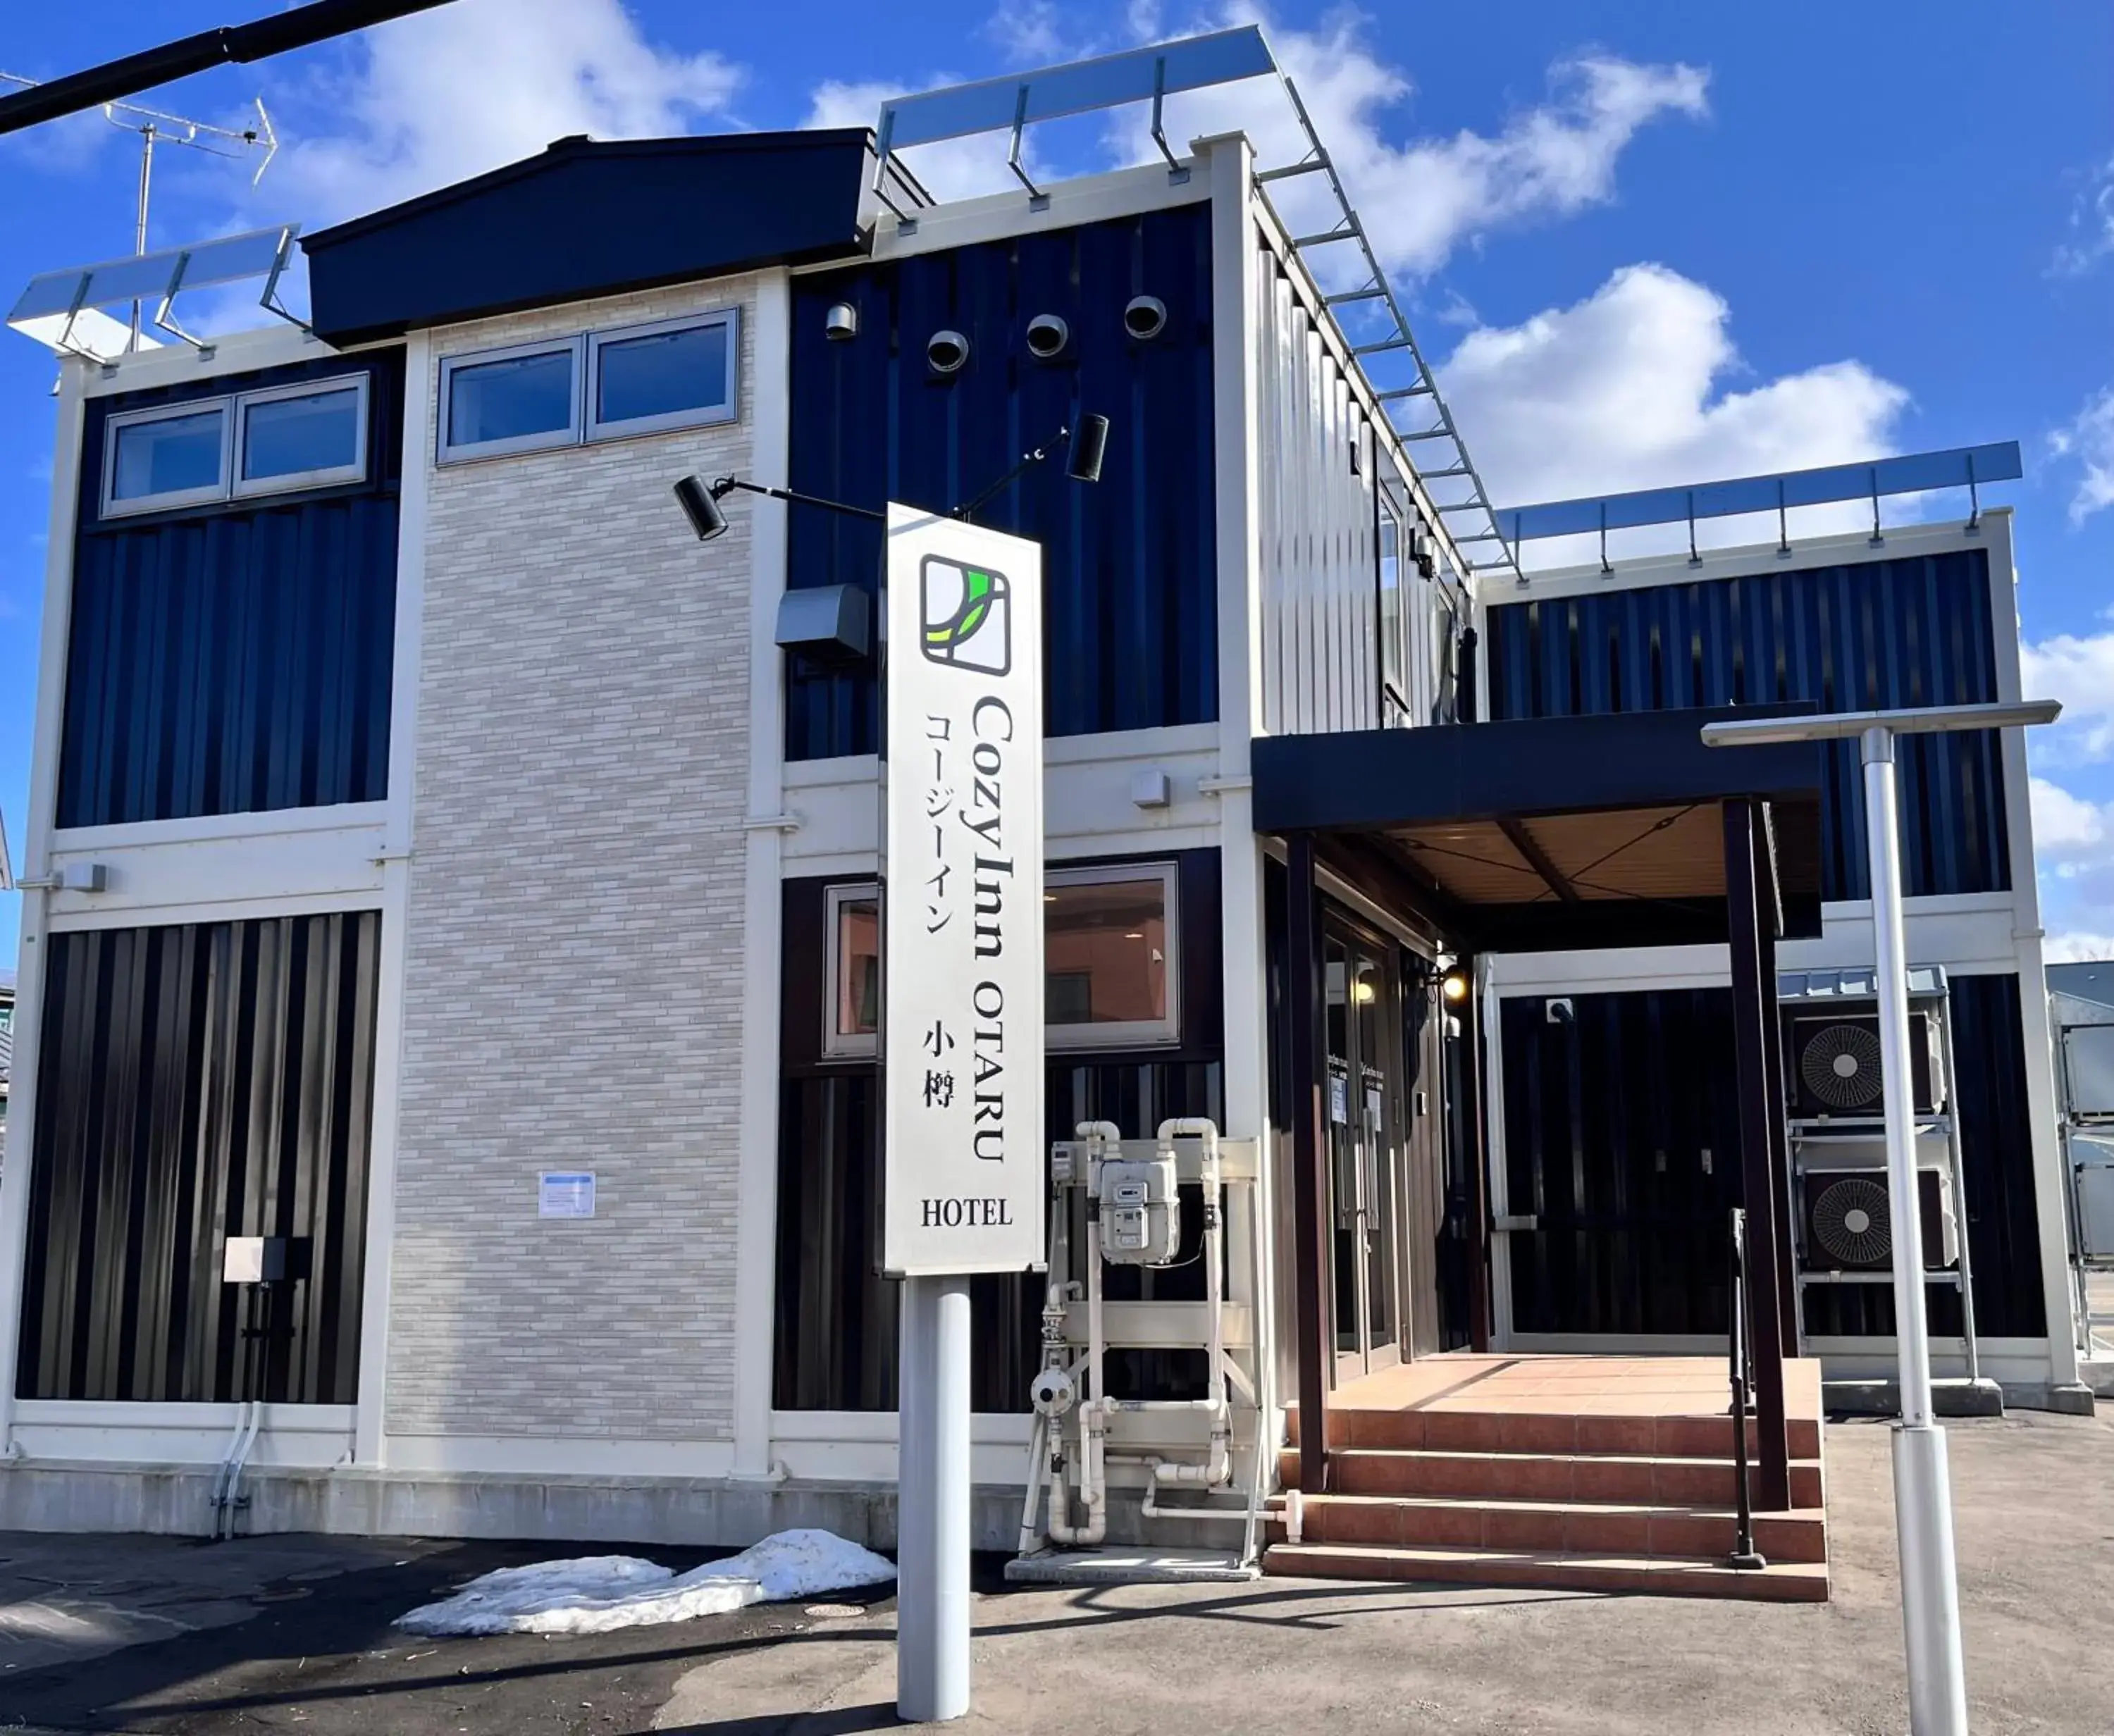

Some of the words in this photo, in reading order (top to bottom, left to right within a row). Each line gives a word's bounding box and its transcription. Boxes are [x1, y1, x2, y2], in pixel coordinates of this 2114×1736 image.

[926, 714, 954, 934] コージーイン
[959, 695, 1013, 850] Cozy
[974, 852, 1014, 961] Inn
[922, 1019, 956, 1109] 小樽
[973, 980, 1004, 1164] OTARU
[921, 1198, 1013, 1227] HOTEL
